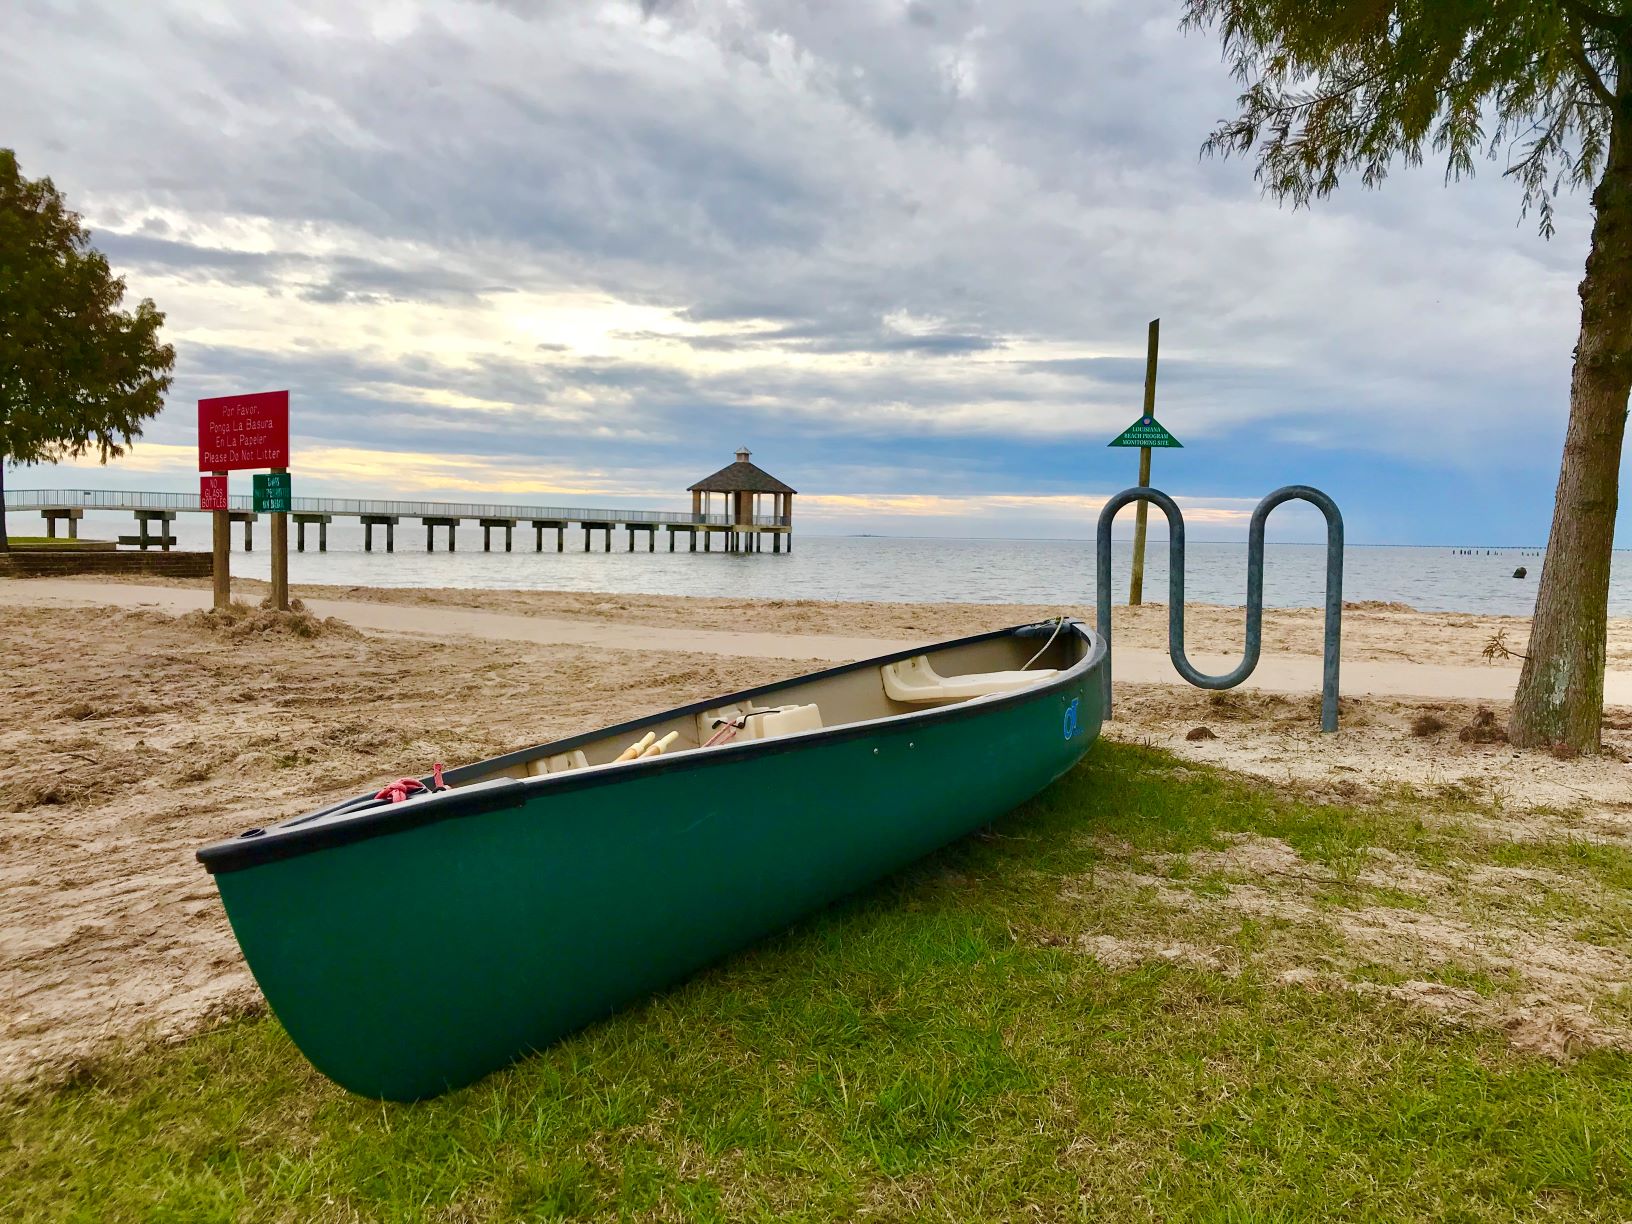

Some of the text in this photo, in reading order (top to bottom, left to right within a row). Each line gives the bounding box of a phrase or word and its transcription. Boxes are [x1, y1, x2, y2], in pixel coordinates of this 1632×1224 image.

[223, 405, 234, 416] Por
[210, 418, 273, 434] Ponga La Basura
[216, 436, 224, 448] En
[226, 436, 237, 447] La
[204, 449, 280, 463] Please Do Not Litter
[210, 478, 218, 488] NO
[204, 488, 223, 498] GLASS
[202, 498, 226, 508] BOTTLES
